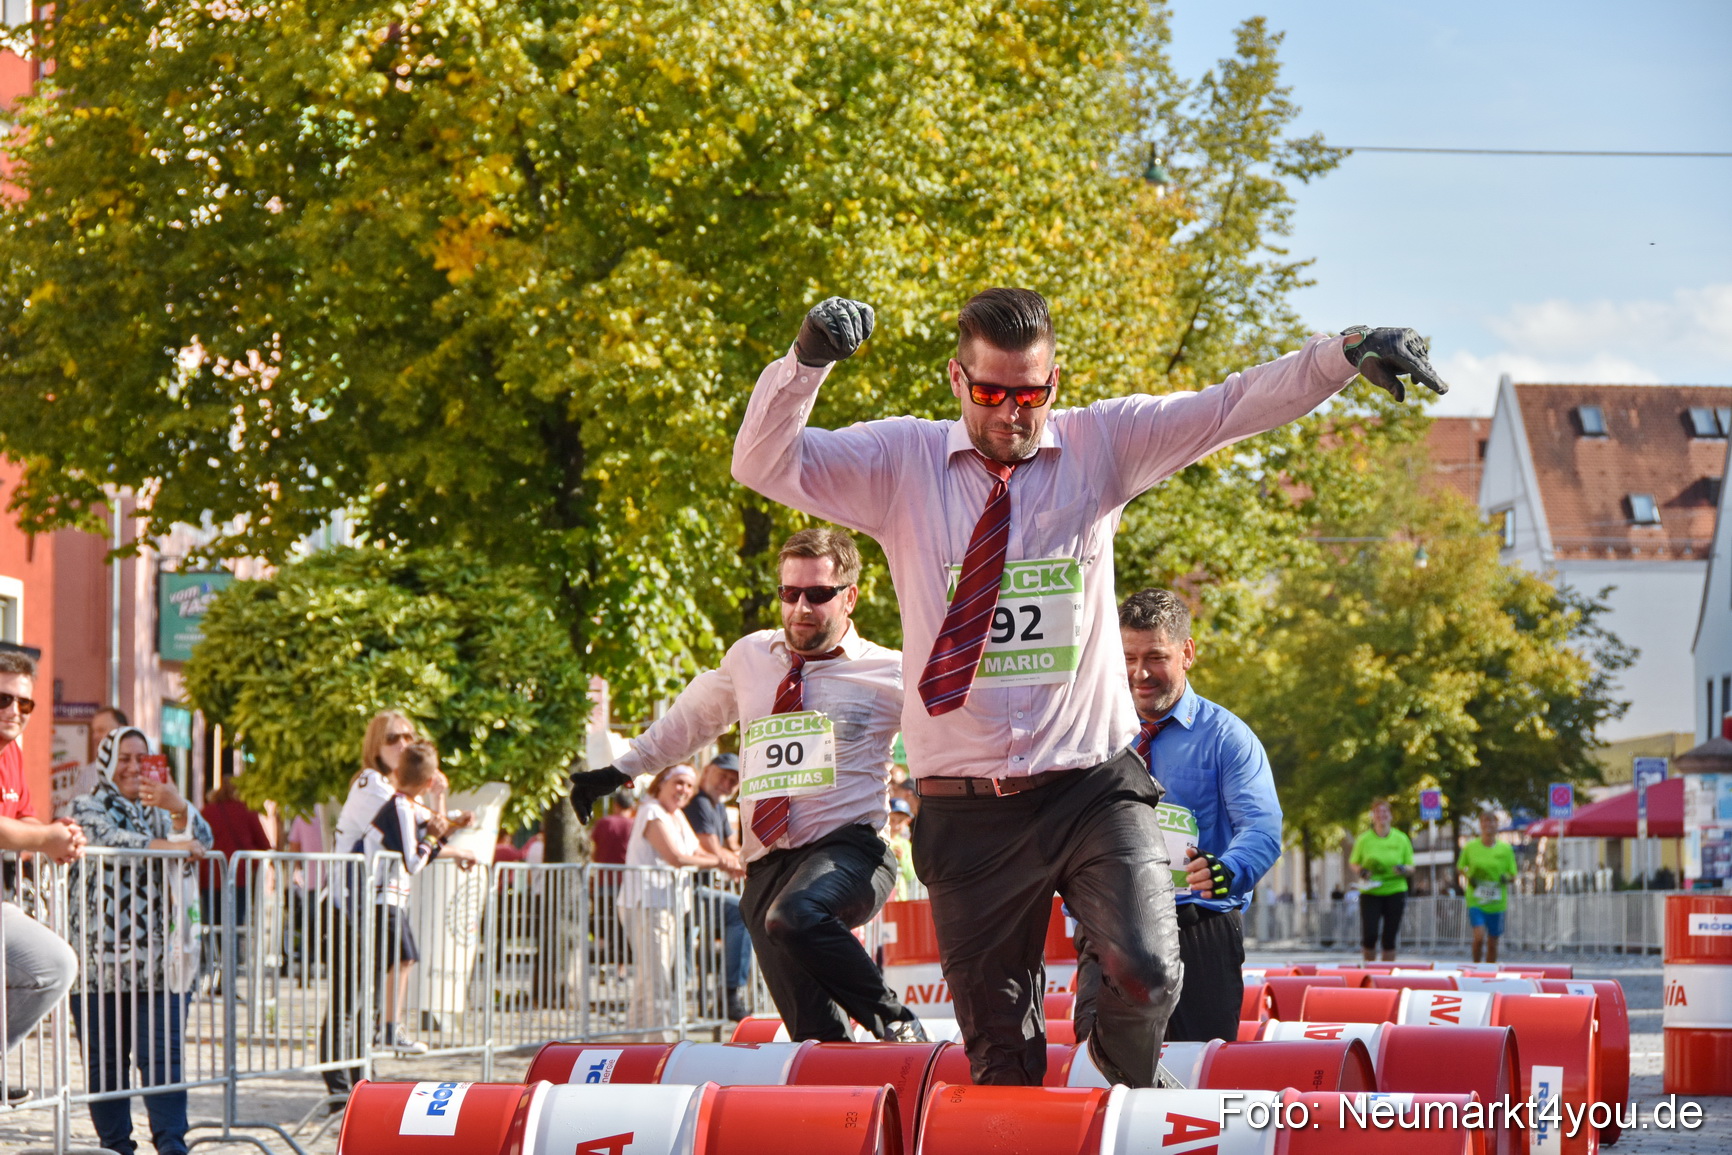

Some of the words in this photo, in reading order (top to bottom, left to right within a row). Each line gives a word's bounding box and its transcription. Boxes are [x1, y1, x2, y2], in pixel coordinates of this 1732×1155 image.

[991, 604, 1044, 644] 92
[984, 652, 1055, 673] MARIO
[749, 713, 827, 745] BOCK
[766, 741, 804, 769] 90
[748, 771, 823, 793] MATTHIAS
[1155, 807, 1192, 832] CK
[1429, 994, 1463, 1025] AV
[602, 1059, 616, 1084] nergie
[844, 1111, 859, 1129] 323
